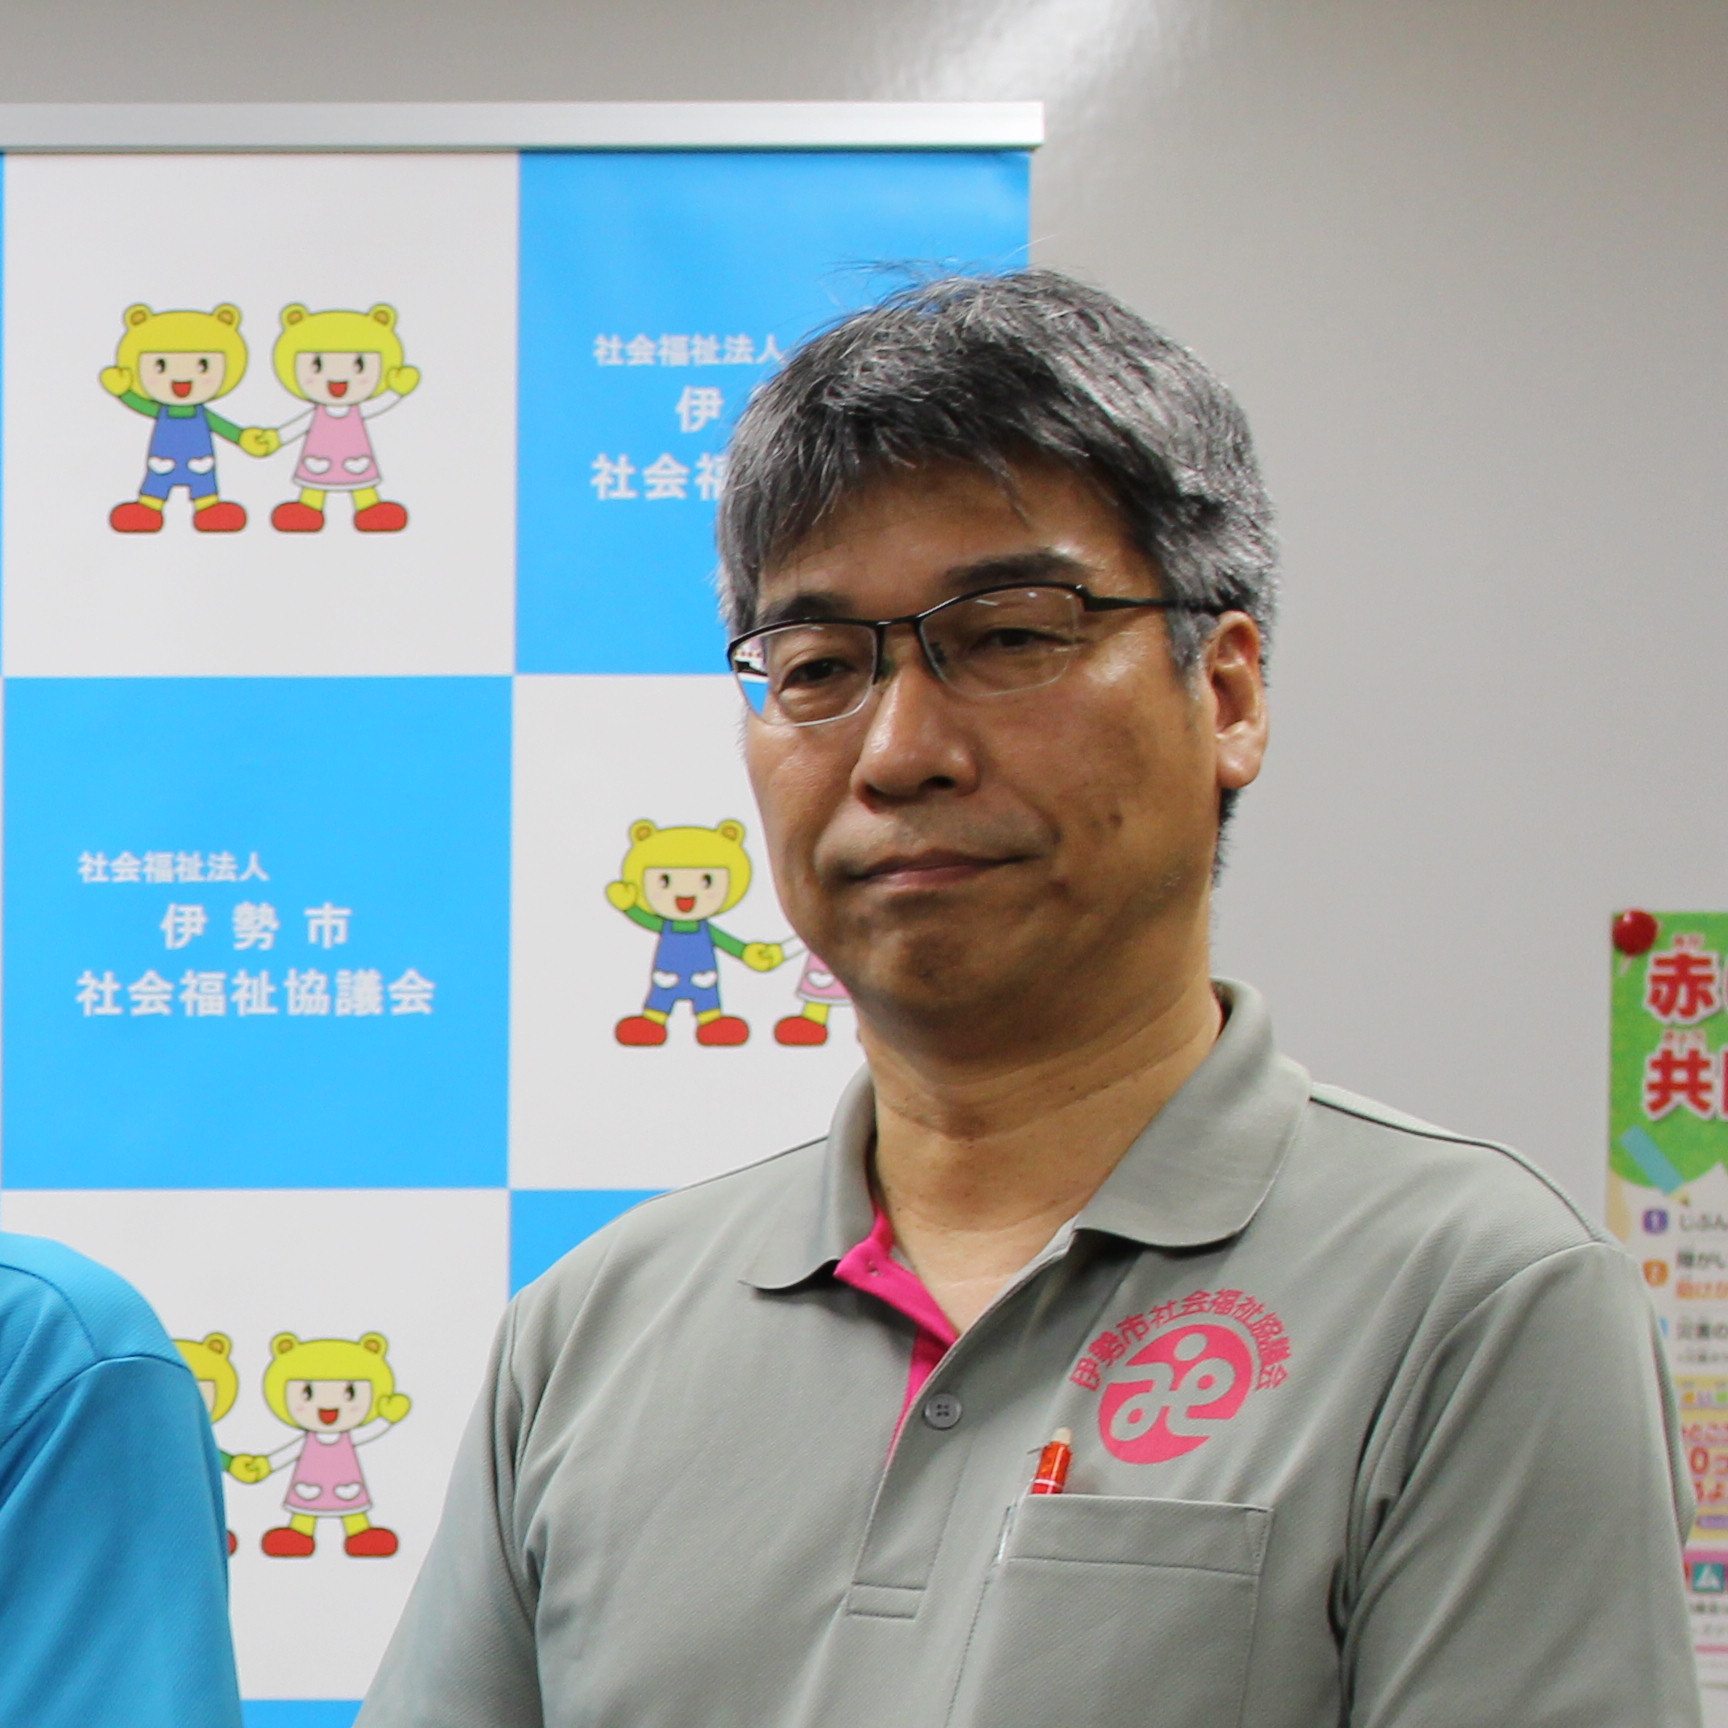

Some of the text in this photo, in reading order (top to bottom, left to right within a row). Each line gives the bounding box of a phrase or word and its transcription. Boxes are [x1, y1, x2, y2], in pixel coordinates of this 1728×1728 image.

[78, 852, 269, 882] 社会福祉法人
[160, 902, 352, 950] 伊勢市
[76, 969, 435, 1016] 社会福祉協議会
